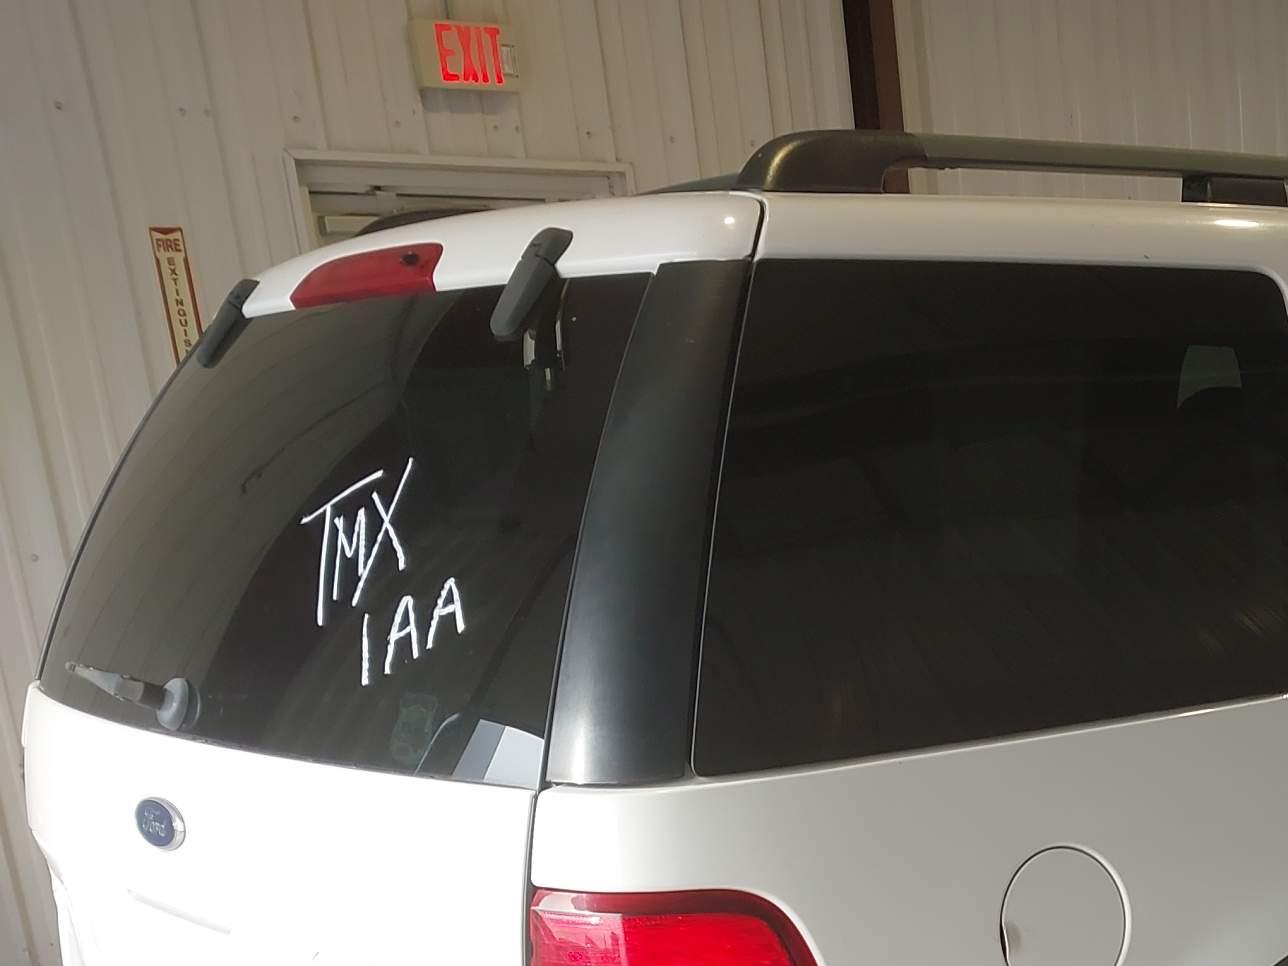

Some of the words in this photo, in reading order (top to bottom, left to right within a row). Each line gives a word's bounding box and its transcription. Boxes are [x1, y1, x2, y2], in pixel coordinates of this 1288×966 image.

[434, 23, 504, 84] EXIT
[155, 238, 182, 252] FIRE
[166, 257, 192, 355] EXTINGUIS
[300, 457, 414, 626] TMX
[361, 577, 466, 687] IAA
